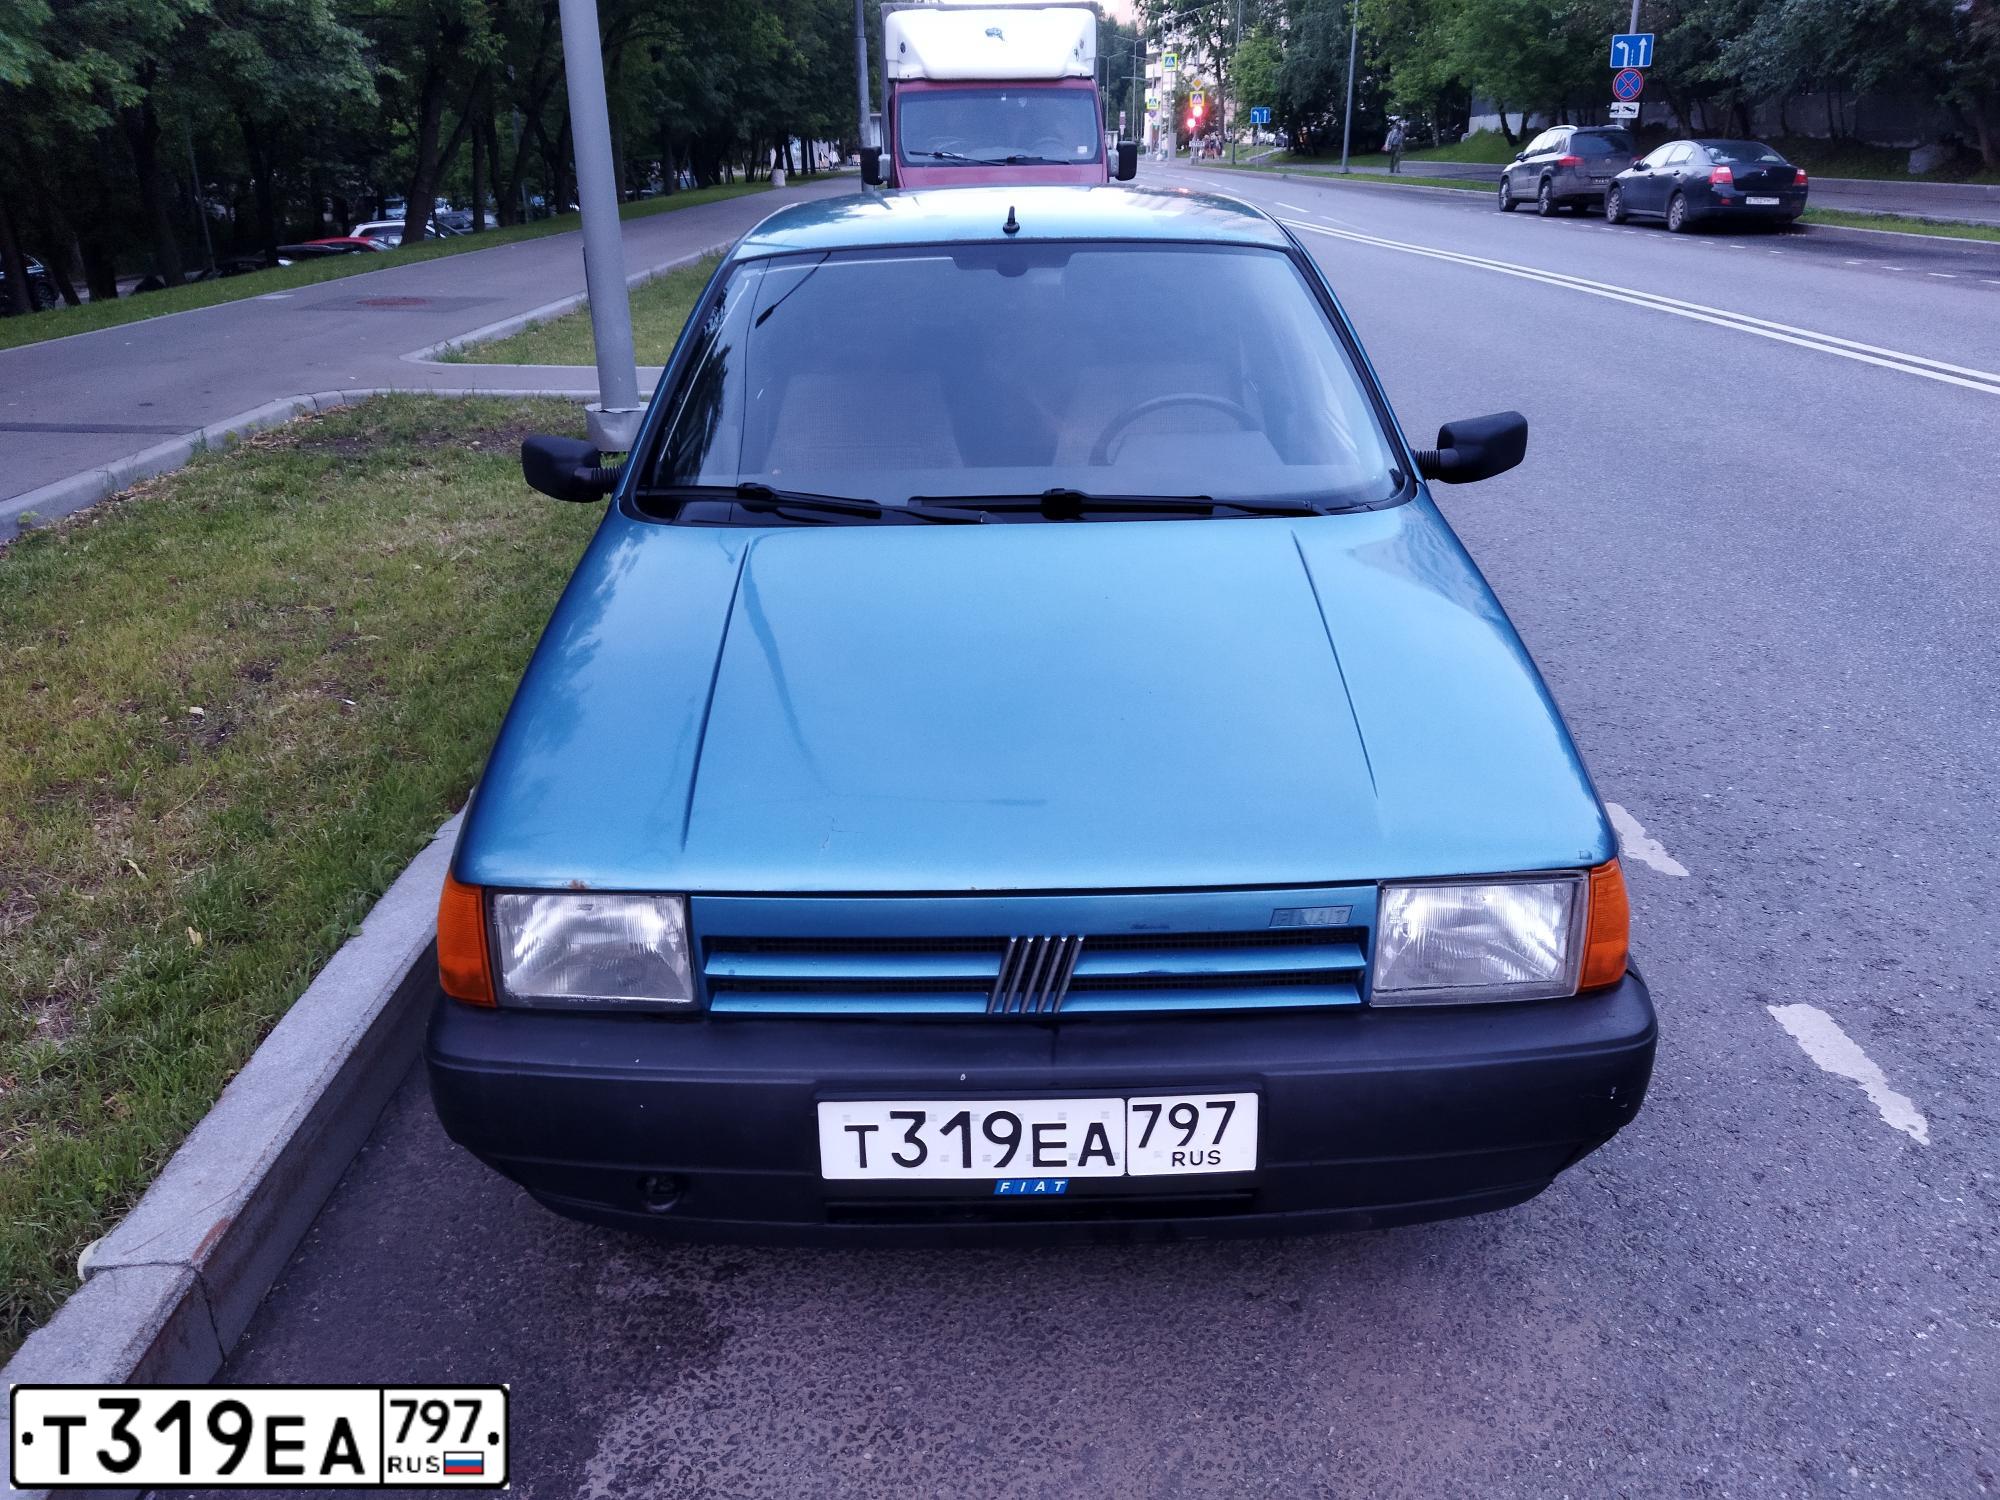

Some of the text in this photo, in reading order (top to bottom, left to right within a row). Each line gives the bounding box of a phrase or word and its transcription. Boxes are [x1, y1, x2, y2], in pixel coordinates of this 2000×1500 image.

[843, 1100, 1237, 1169] T319EA 797
[1171, 1149, 1222, 1167] RUS
[1000, 1180, 1066, 1193] FIAT
